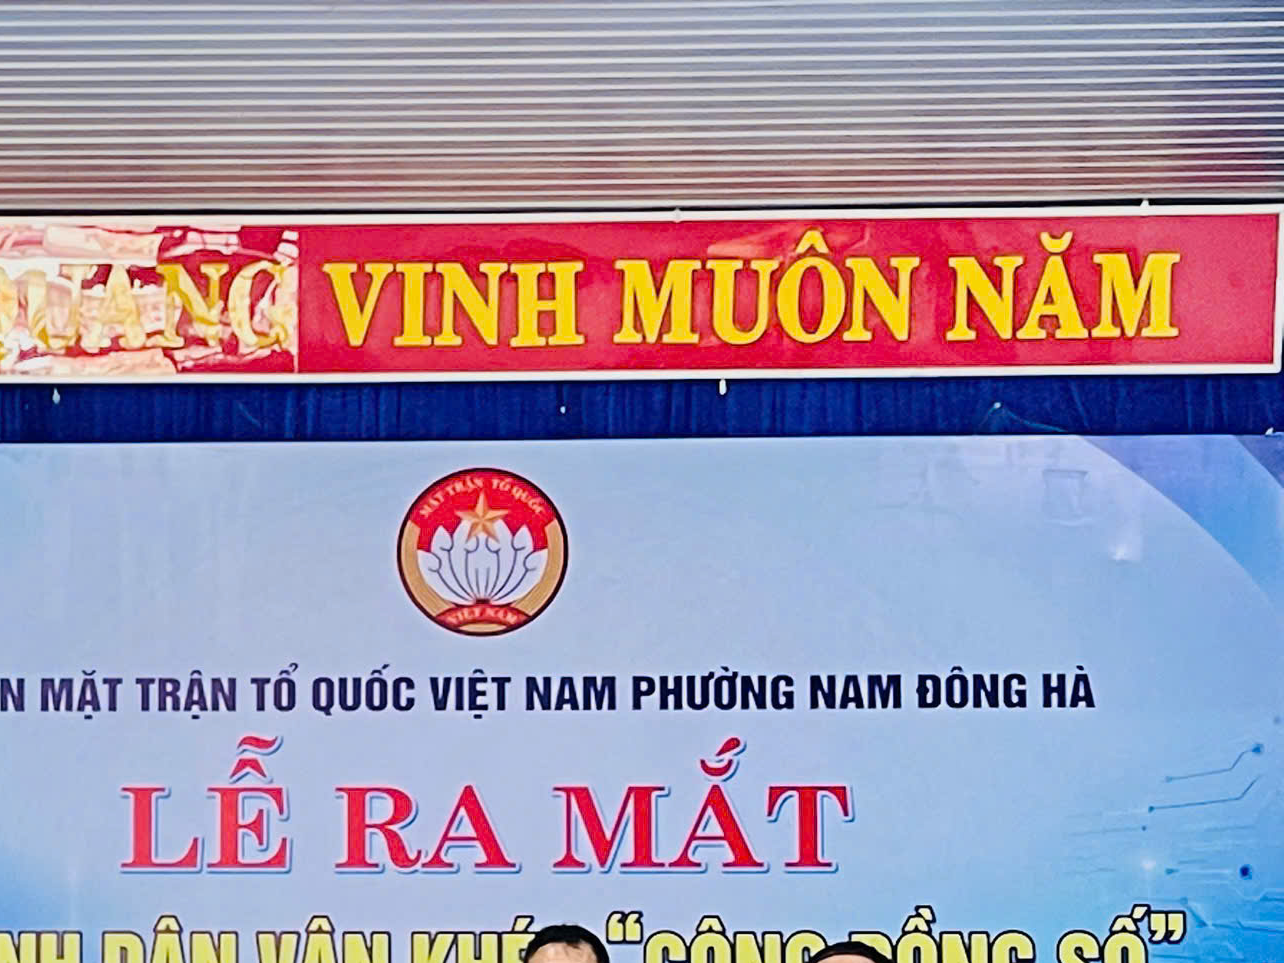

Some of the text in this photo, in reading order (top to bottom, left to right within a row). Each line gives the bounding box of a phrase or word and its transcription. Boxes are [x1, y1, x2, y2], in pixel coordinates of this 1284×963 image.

[322, 262, 584, 347] VINH
[614, 230, 920, 345] MUÔN
[946, 231, 1181, 341] NĂM
[40, 669, 123, 720] MẶT
[135, 669, 237, 720] TRẬN
[250, 662, 300, 713] TỔ
[311, 663, 416, 717] QUỐC
[429, 668, 513, 721] VIỆT
[525, 675, 617, 711] NAM
[631, 666, 795, 711] PHƯỜNG
[809, 674, 903, 710] NAM
[915, 665, 1028, 710] ĐÔNG
[1042, 665, 1097, 709] HÀ
[120, 735, 852, 871] LỄ RA MẮT
